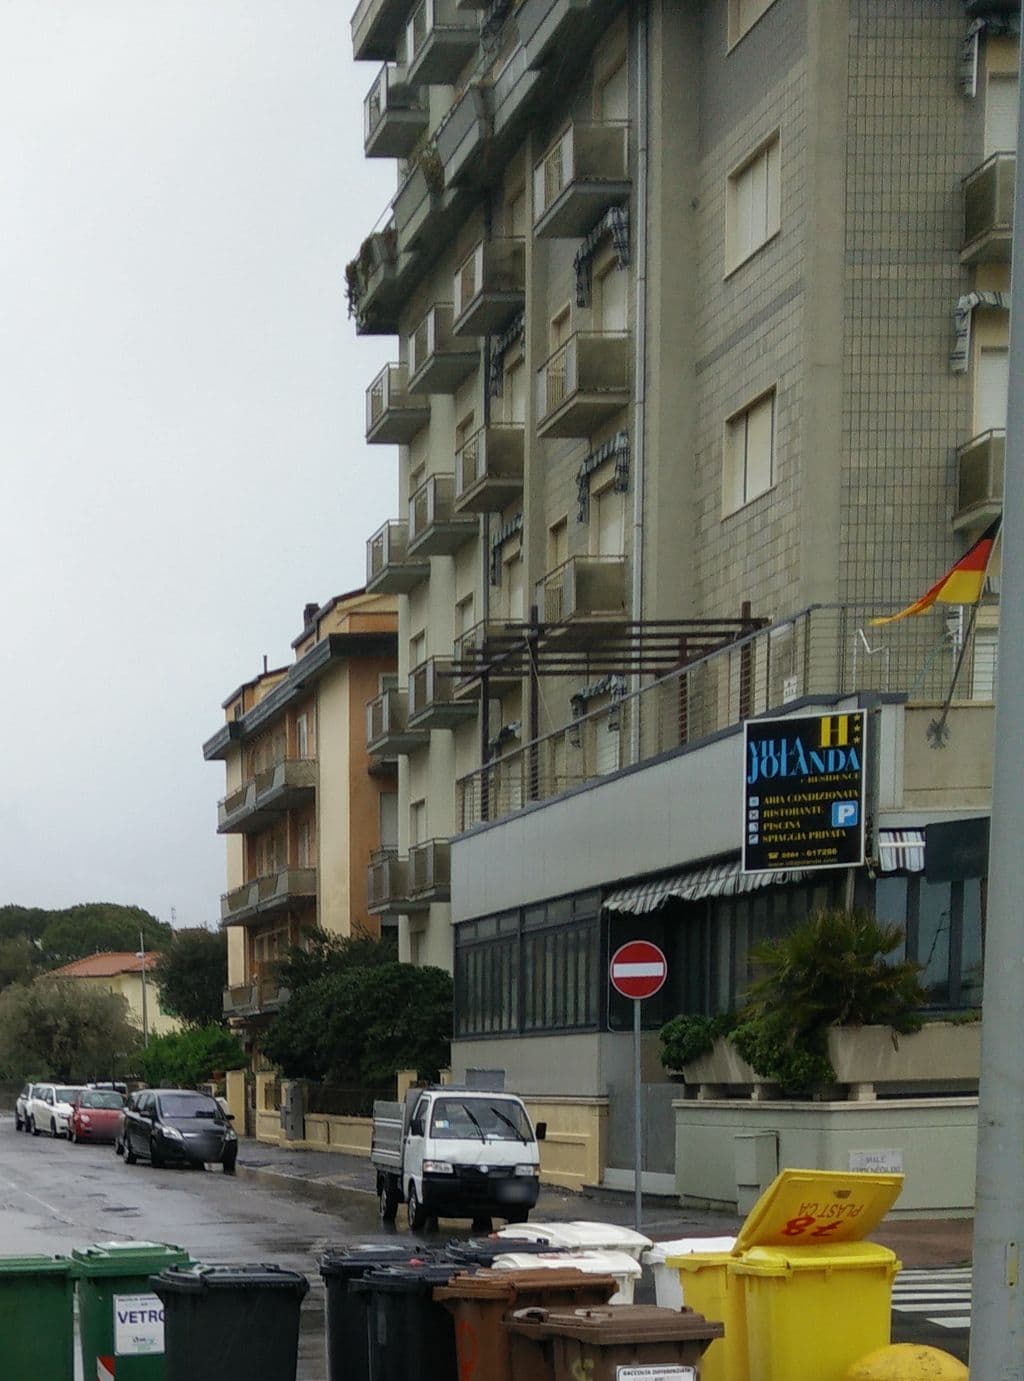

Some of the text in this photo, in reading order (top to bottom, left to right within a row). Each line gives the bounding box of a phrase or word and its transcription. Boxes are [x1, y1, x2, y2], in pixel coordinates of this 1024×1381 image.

[820, 715, 848, 747] H
[748, 743, 860, 784] JOLANDA
[807, 773, 859, 784] RESIDENCE
[764, 789, 859, 805] ARIA CONDIZIONATA
[763, 805, 824, 818] RISTORANTE
[763, 820, 801, 831] PISCINA
[762, 829, 846, 843] SPIAGGIA PRIVATA
